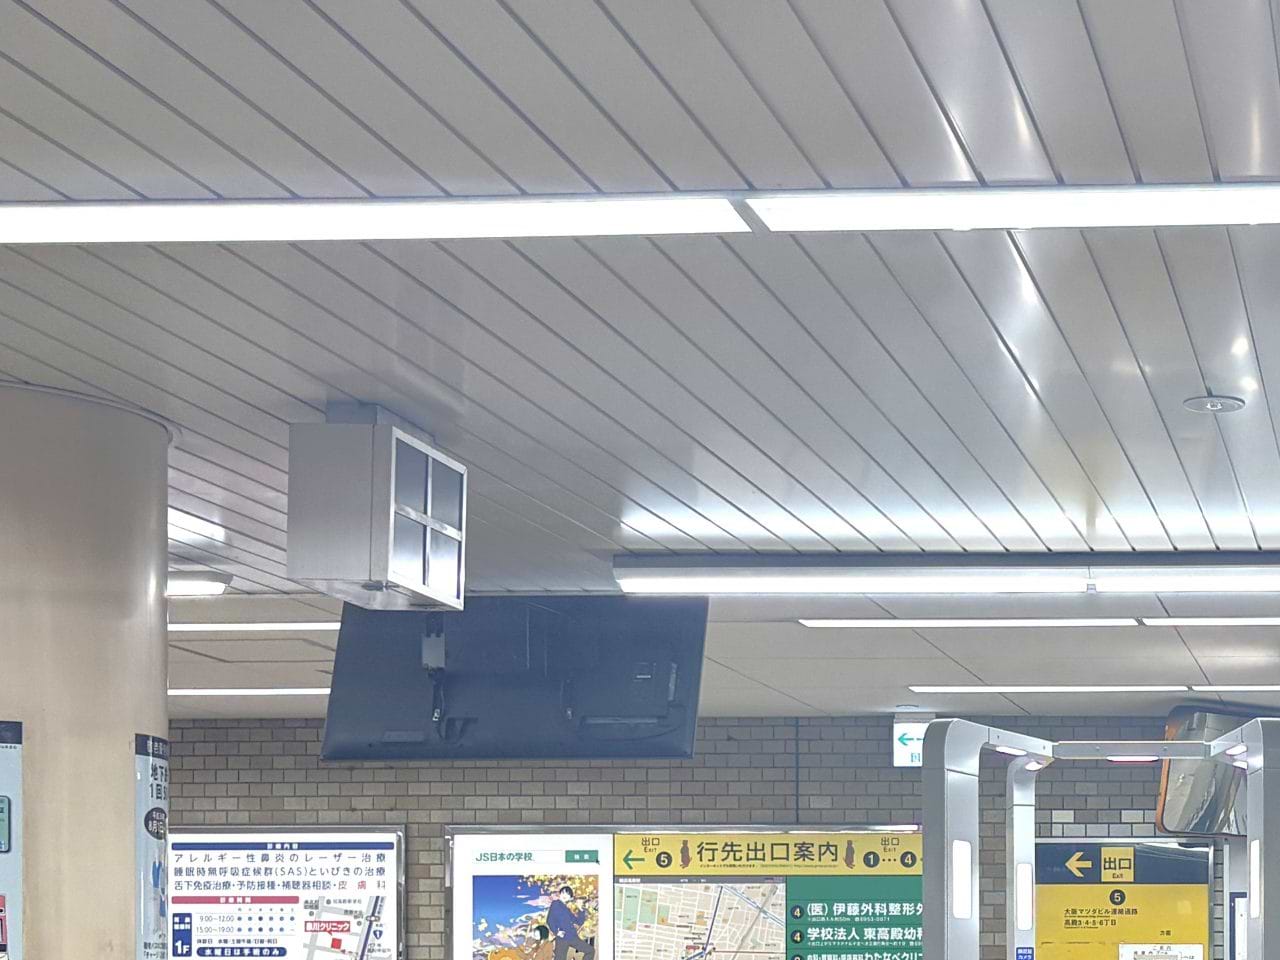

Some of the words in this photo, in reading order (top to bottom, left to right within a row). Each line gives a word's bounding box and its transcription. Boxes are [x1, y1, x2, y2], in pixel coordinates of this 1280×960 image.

[641, 837, 660, 846] 出口
[881, 837, 900, 846] 出口
[174, 852, 386, 863] アレルギー性鼻炎のレーザー治療
[476, 852, 533, 862] JS日本の学校
[697, 842, 838, 862] 行先出口案内
[1103, 857, 1132, 871] 出口
[807, 903, 828, 916] (医)
[807, 928, 860, 941] 学校法人
[175, 940, 190, 955] 1F
